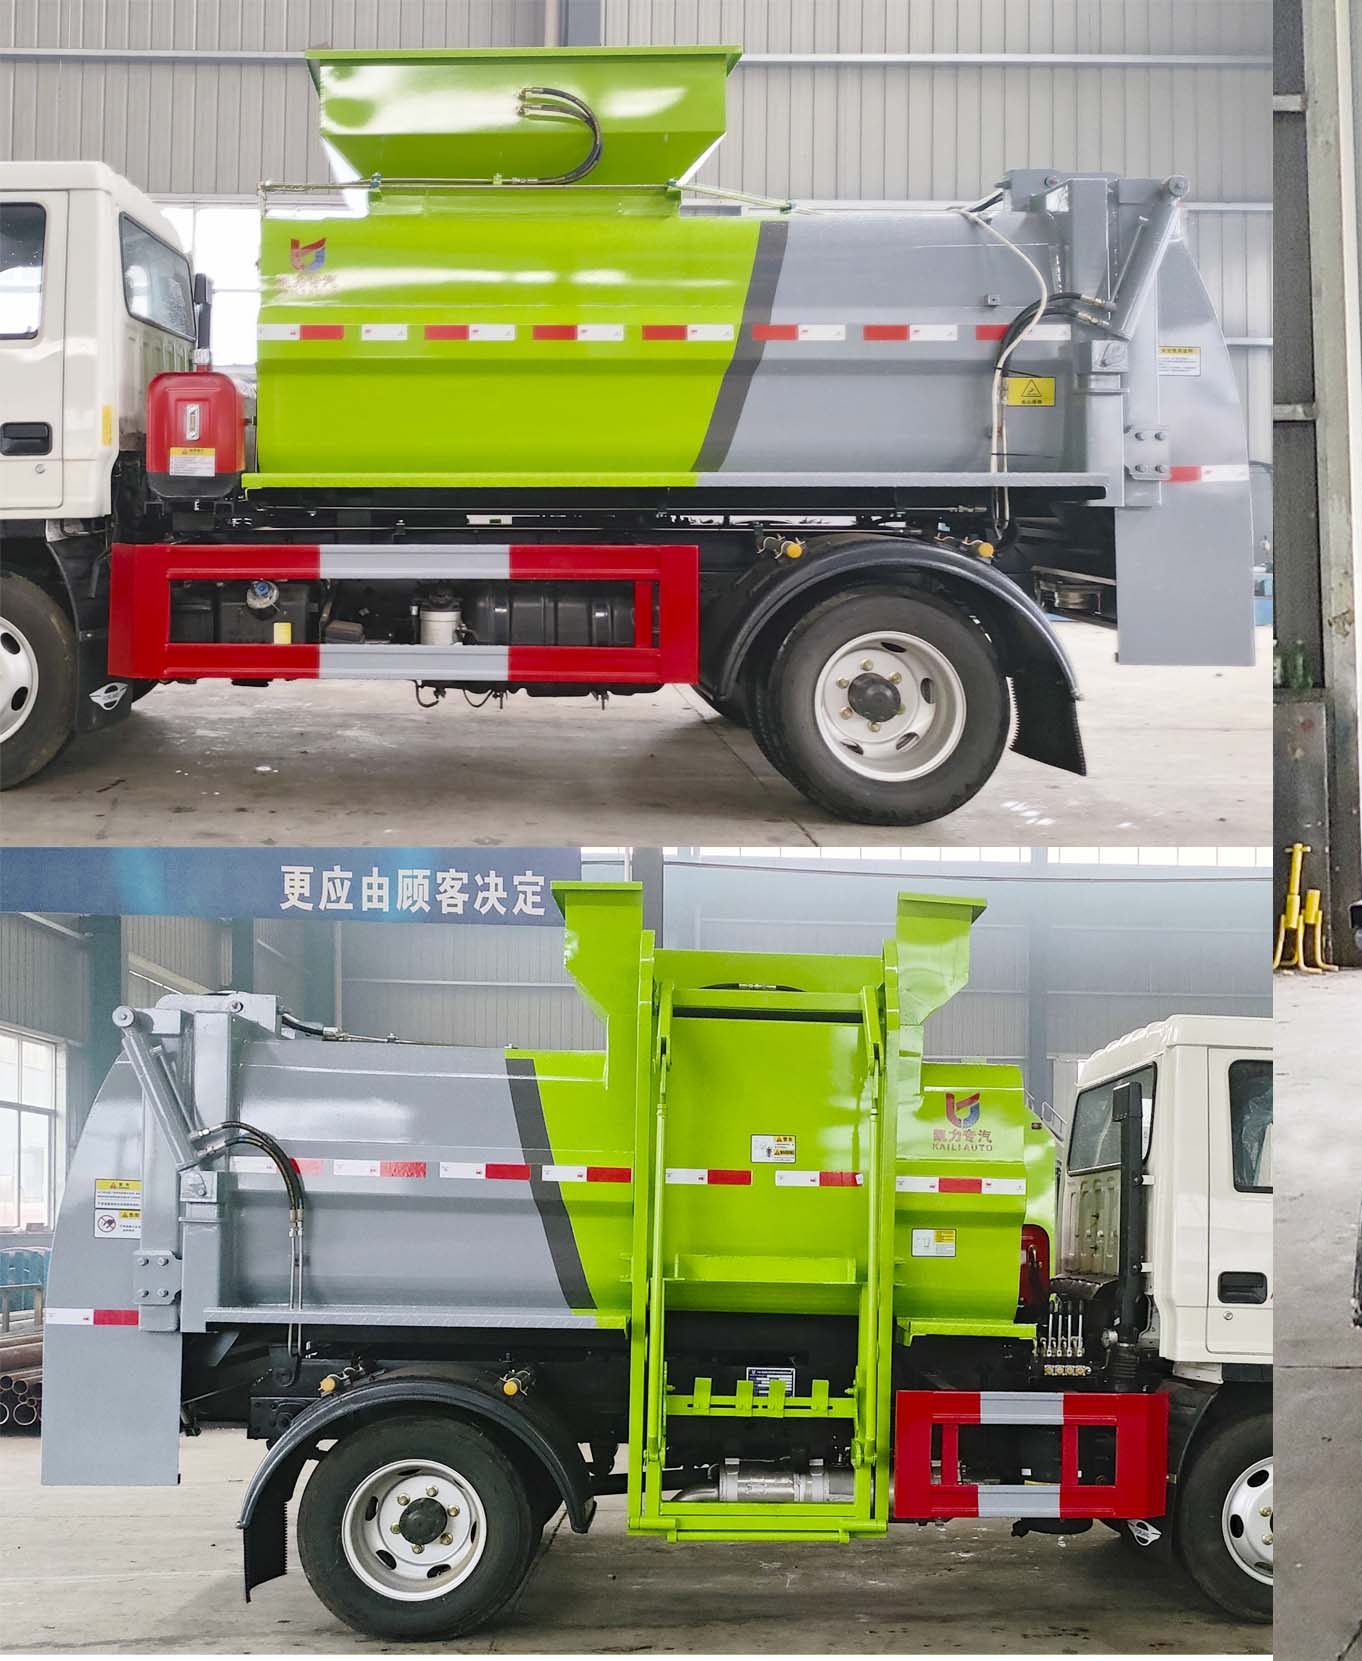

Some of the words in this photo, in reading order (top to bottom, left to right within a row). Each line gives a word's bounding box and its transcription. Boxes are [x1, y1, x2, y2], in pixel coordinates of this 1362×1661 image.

[279, 864, 546, 916] 更应由顾客决定
